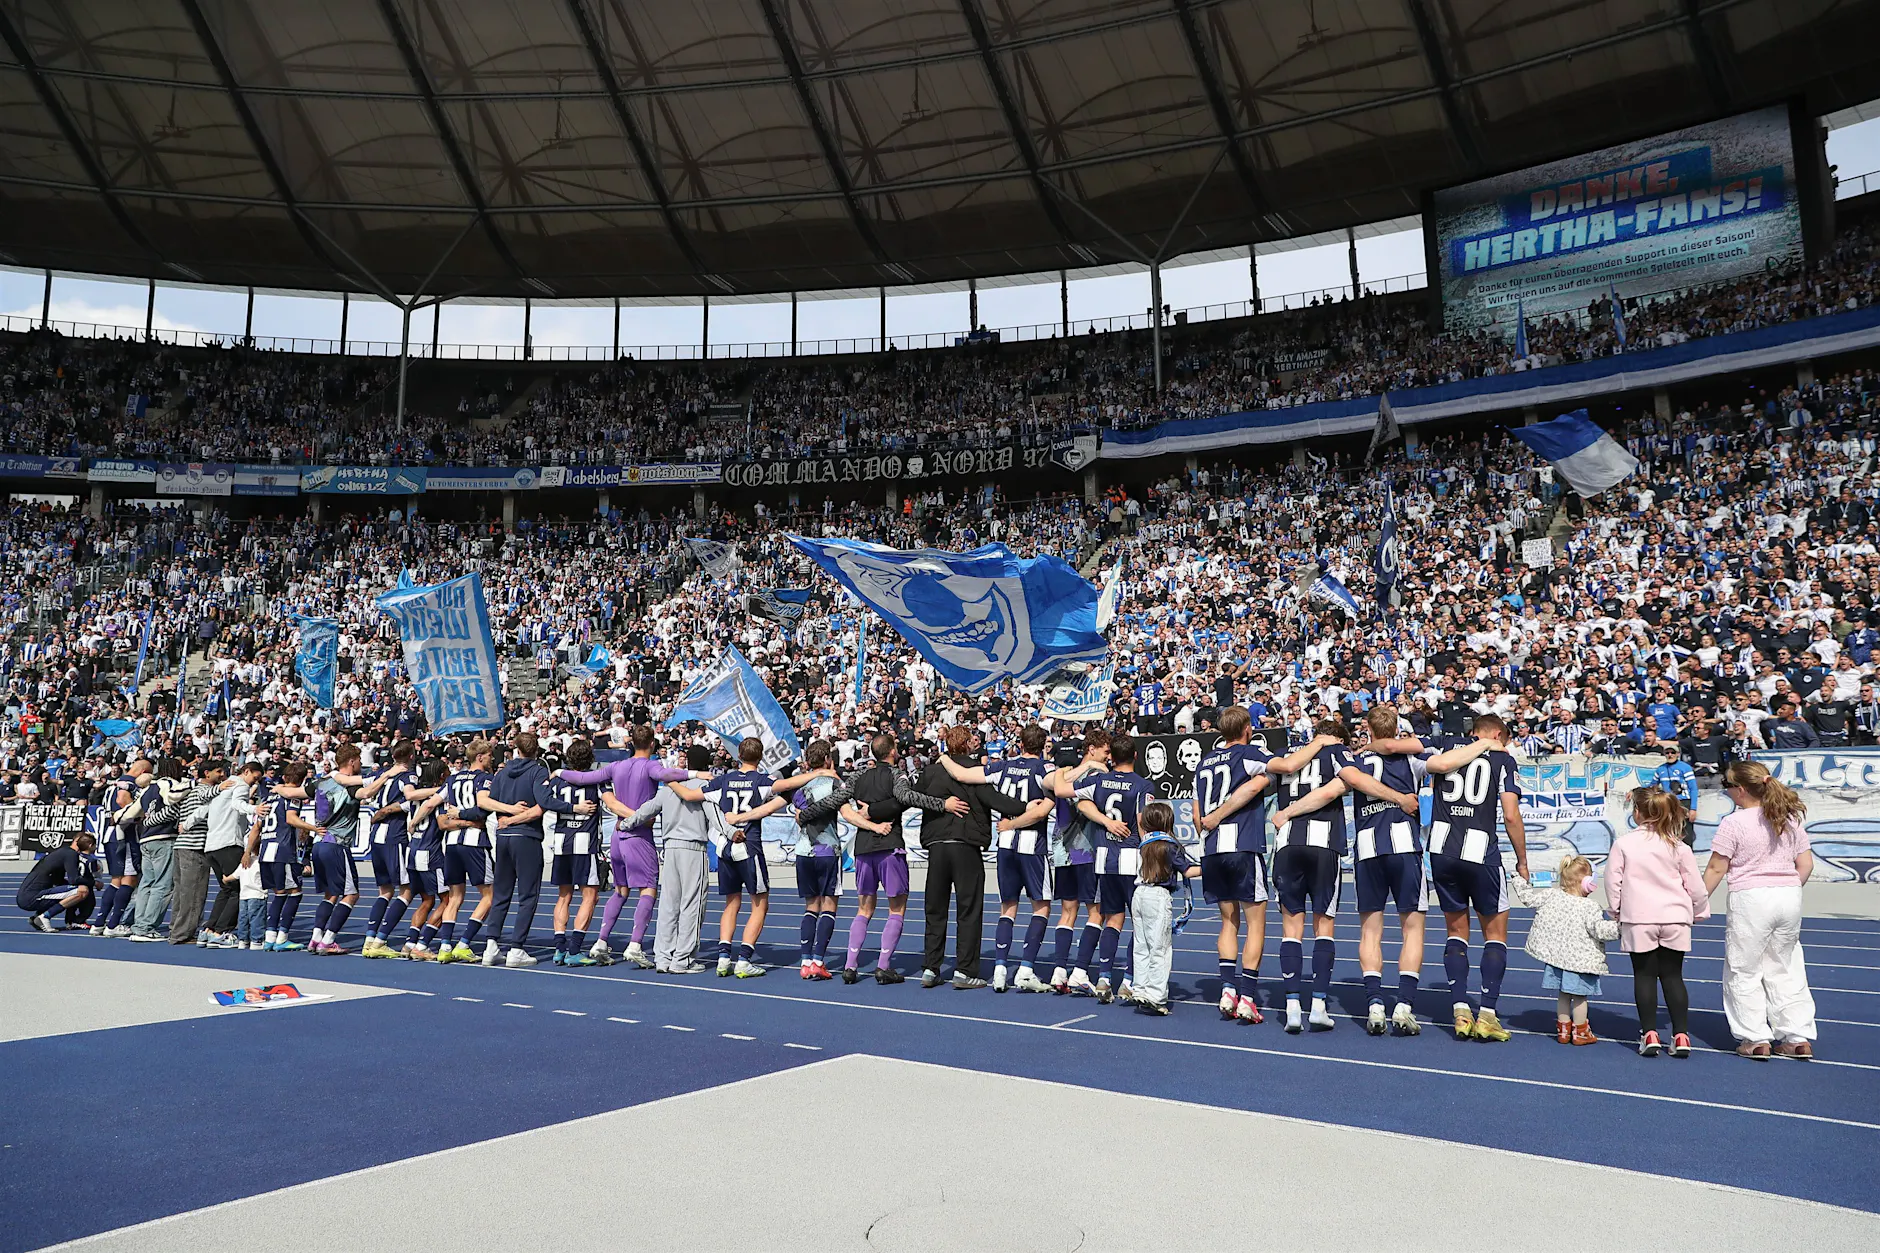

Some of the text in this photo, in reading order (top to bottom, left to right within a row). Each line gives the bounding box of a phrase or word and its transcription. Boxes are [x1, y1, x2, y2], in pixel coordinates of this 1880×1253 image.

[1530, 160, 1680, 222] DANKE,
[1464, 178, 1763, 272] HERTHA-FANS!
[1478, 229, 1754, 293] Danke für euren überragenden Support in dieser Saison!
[1488, 247, 1747, 305] Wir freuen uns auf die kommende Spielzeit mit euch.
[1274, 354, 1294, 363] SEXY
[1052, 439, 1074, 450] CASUAL
[8, 458, 44, 471] Tradition
[117, 462, 136, 470] UND
[930, 446, 1014, 476] NORD
[1022, 444, 1050, 468] 97
[338, 468, 388, 480] HERTHA
[566, 469, 620, 486] Babelsberg
[337, 481, 388, 492] ONKELZ
[1221, 752, 1231, 761] BSC
[1000, 777, 1028, 803] 41
[1102, 780, 1132, 790] HERTHA BSC
[1200, 764, 1232, 816] 22
[452, 781, 475, 810] 18
[560, 786, 590, 820] 11
[25, 804, 86, 816] HERTHA BSC
[1105, 792, 1122, 822] 6
[1450, 806, 1474, 817] SEGUIN
[1555, 808, 1573, 822] für
[1576, 806, 1604, 818] Dich!
[24, 816, 83, 831] HOOLIGANS
